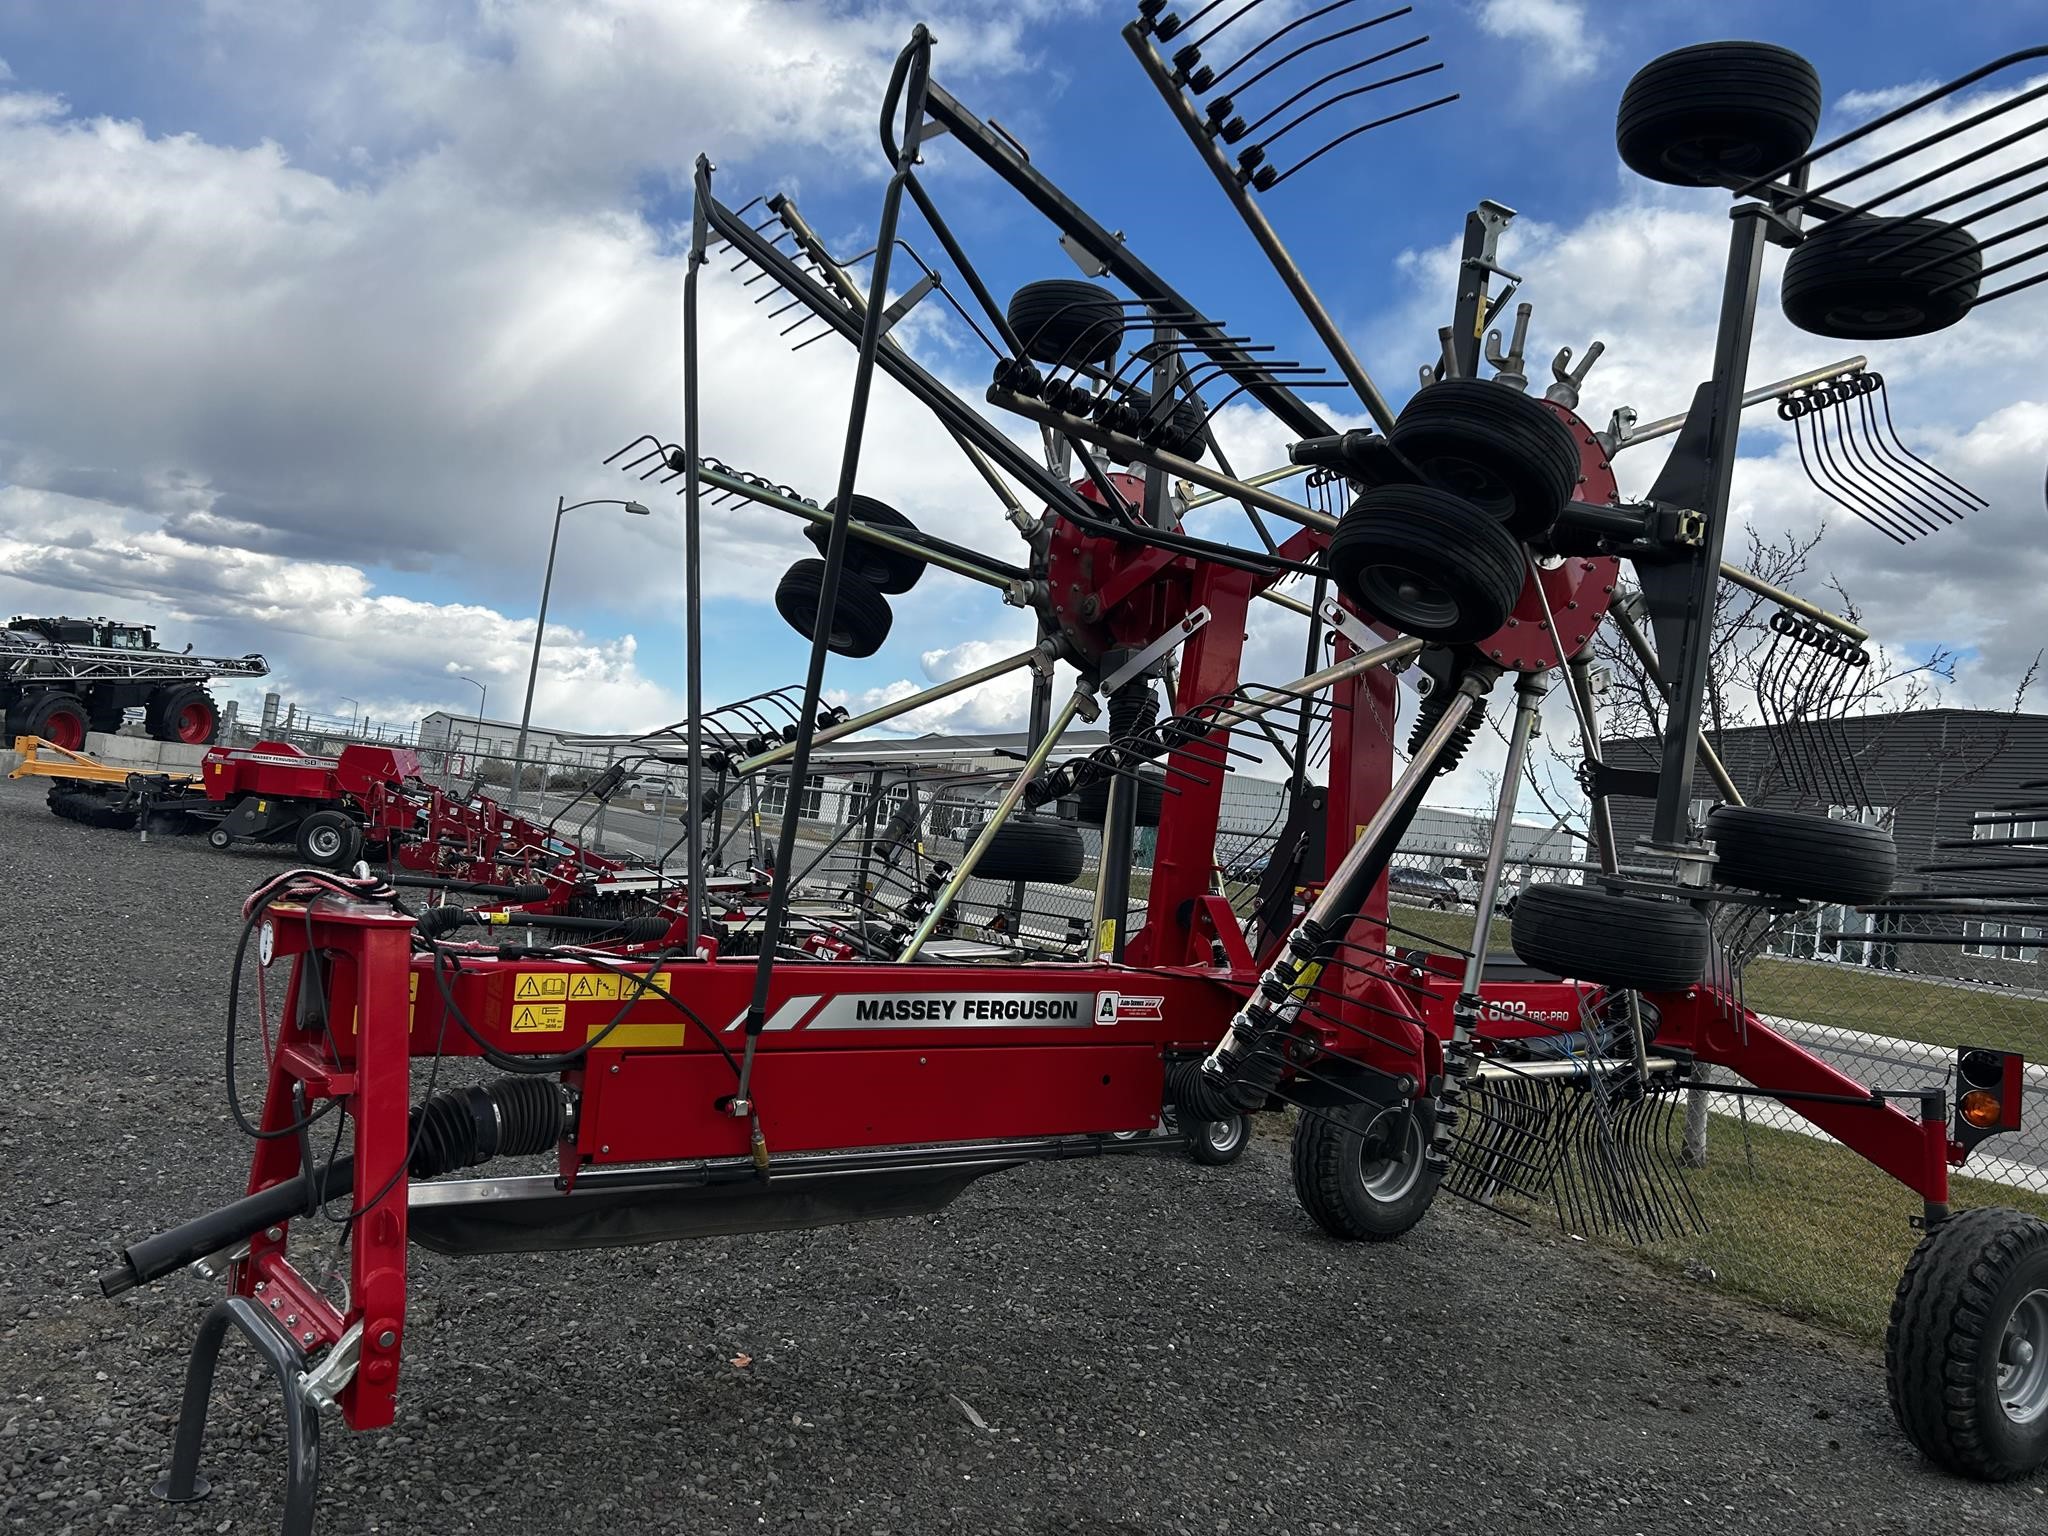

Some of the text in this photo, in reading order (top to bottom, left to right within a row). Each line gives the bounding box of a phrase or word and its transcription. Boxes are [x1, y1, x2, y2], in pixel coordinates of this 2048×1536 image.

[855, 999, 1078, 1021] MASSEY FERGUSON
[1099, 997, 1114, 1017] A
[1527, 1010, 1569, 1021] TRC-PRO
